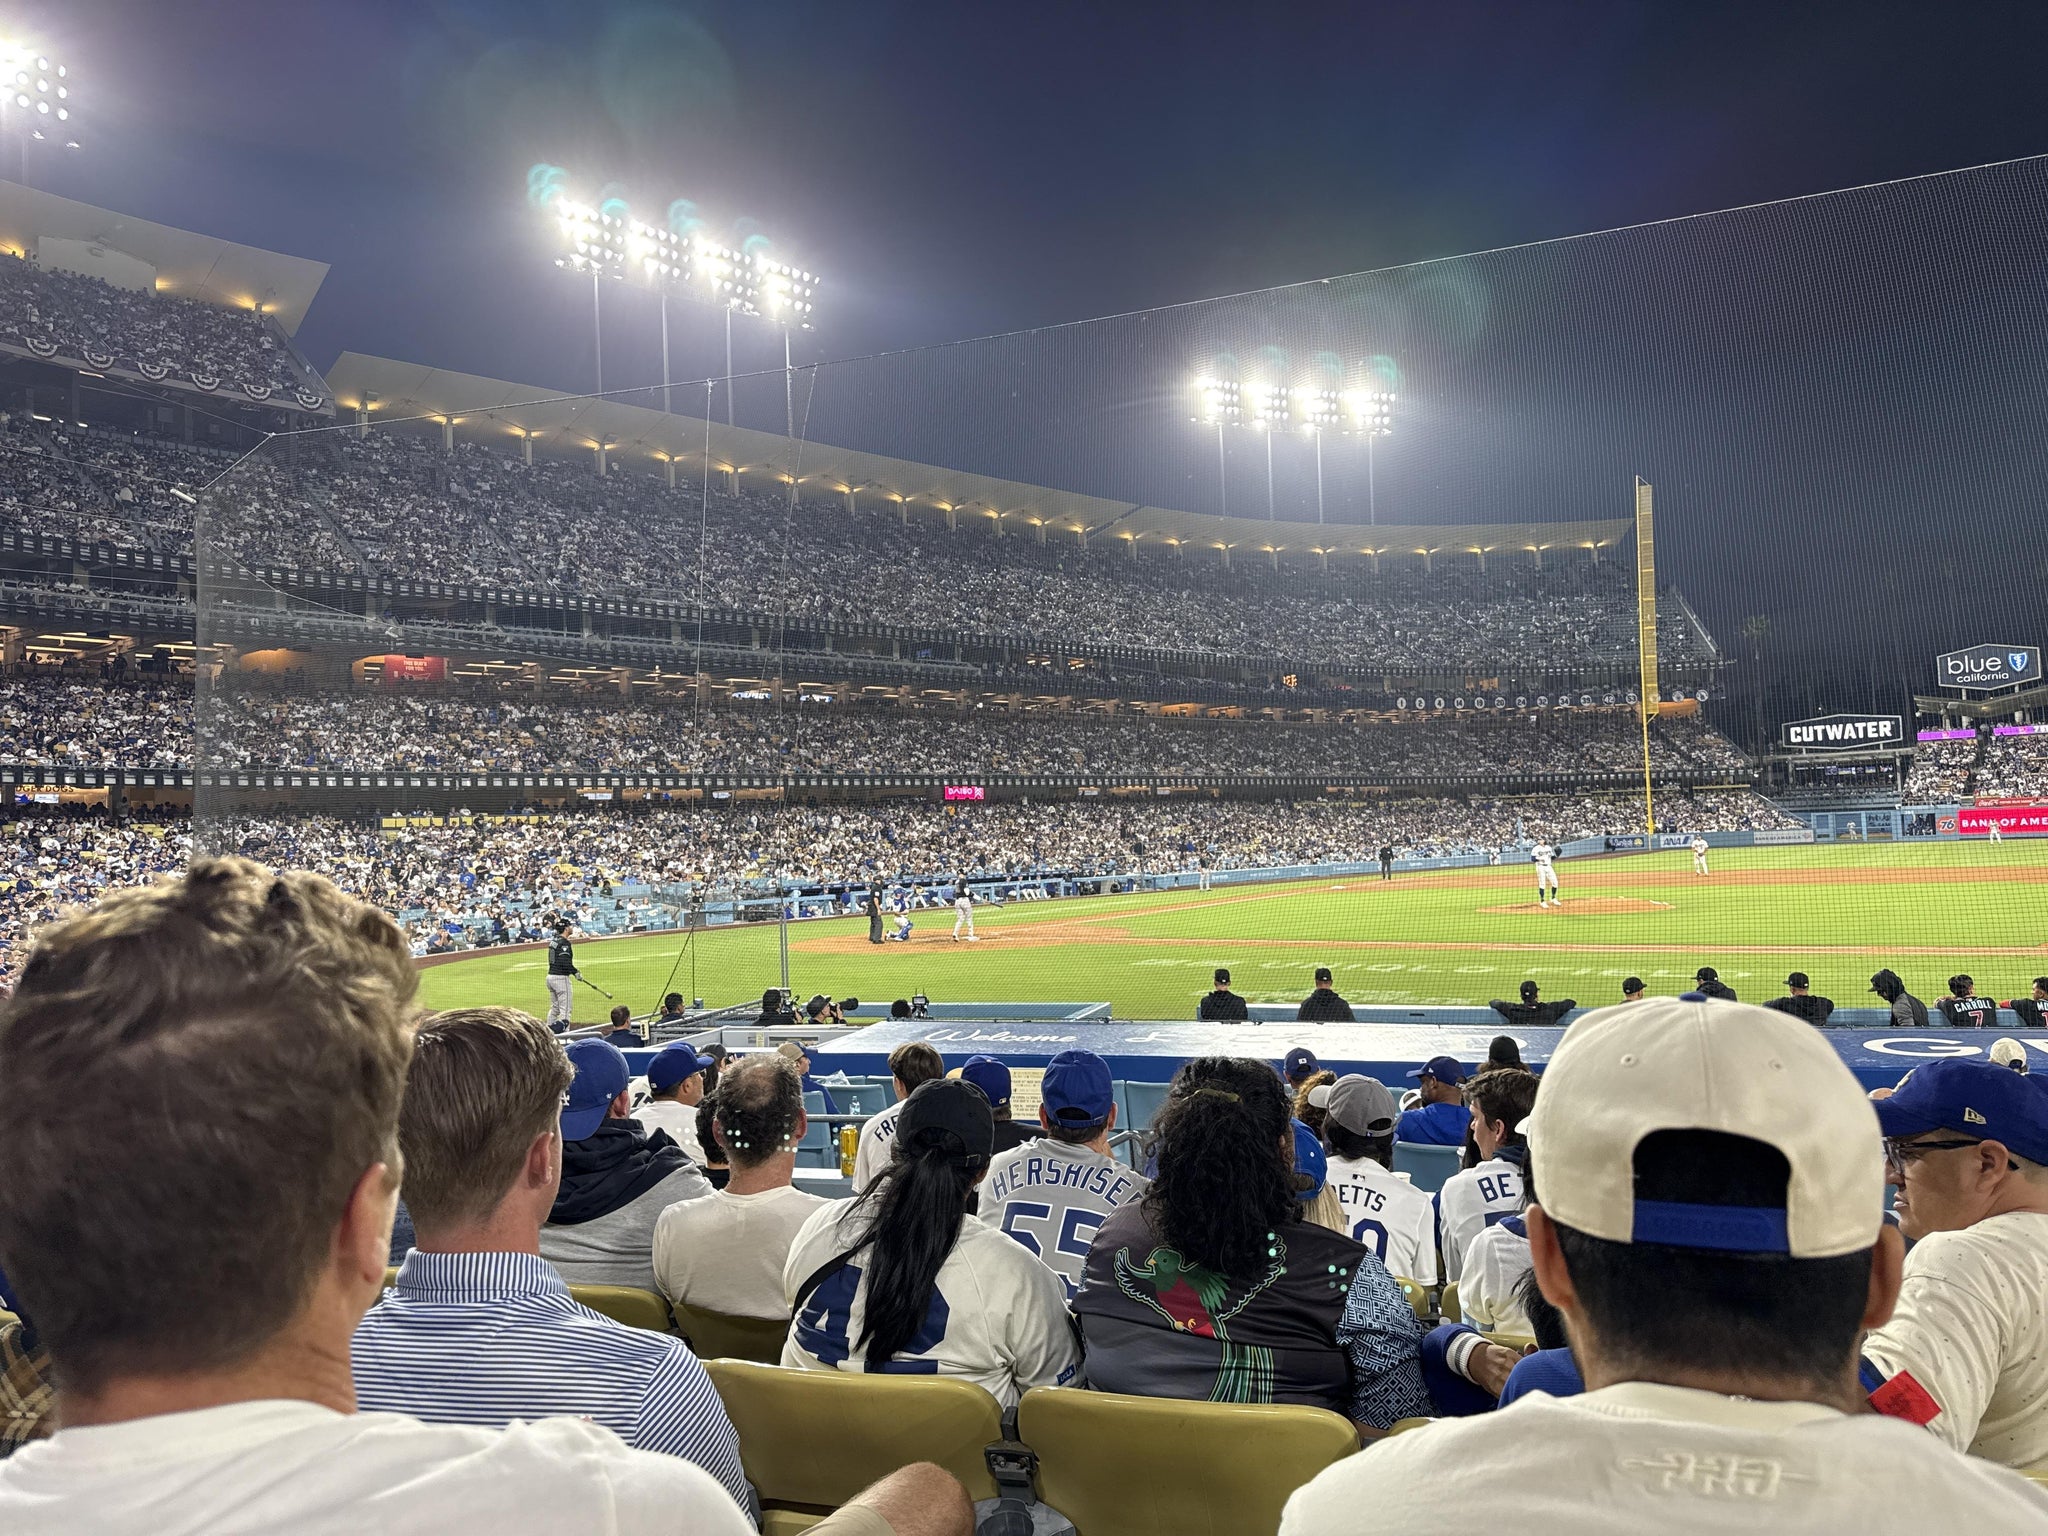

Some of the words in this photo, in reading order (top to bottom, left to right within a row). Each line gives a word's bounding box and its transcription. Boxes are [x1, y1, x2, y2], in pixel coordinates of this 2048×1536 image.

[1947, 655, 2002, 674] blue
[1956, 672, 2009, 683] california
[1790, 720, 1892, 743] CUTWATER
[45, 785, 74, 793] DOGS
[1939, 819, 1955, 831] 76
[2000, 818, 2017, 826] OF
[1663, 837, 1682, 847] ANA
[1954, 1000, 1992, 1012] CARROLL
[1968, 1010, 1984, 1029] 7
[924, 1029, 1079, 1043] Welcome
[1477, 1173, 1524, 1203] BE
[1331, 1184, 1387, 1212] ETTS
